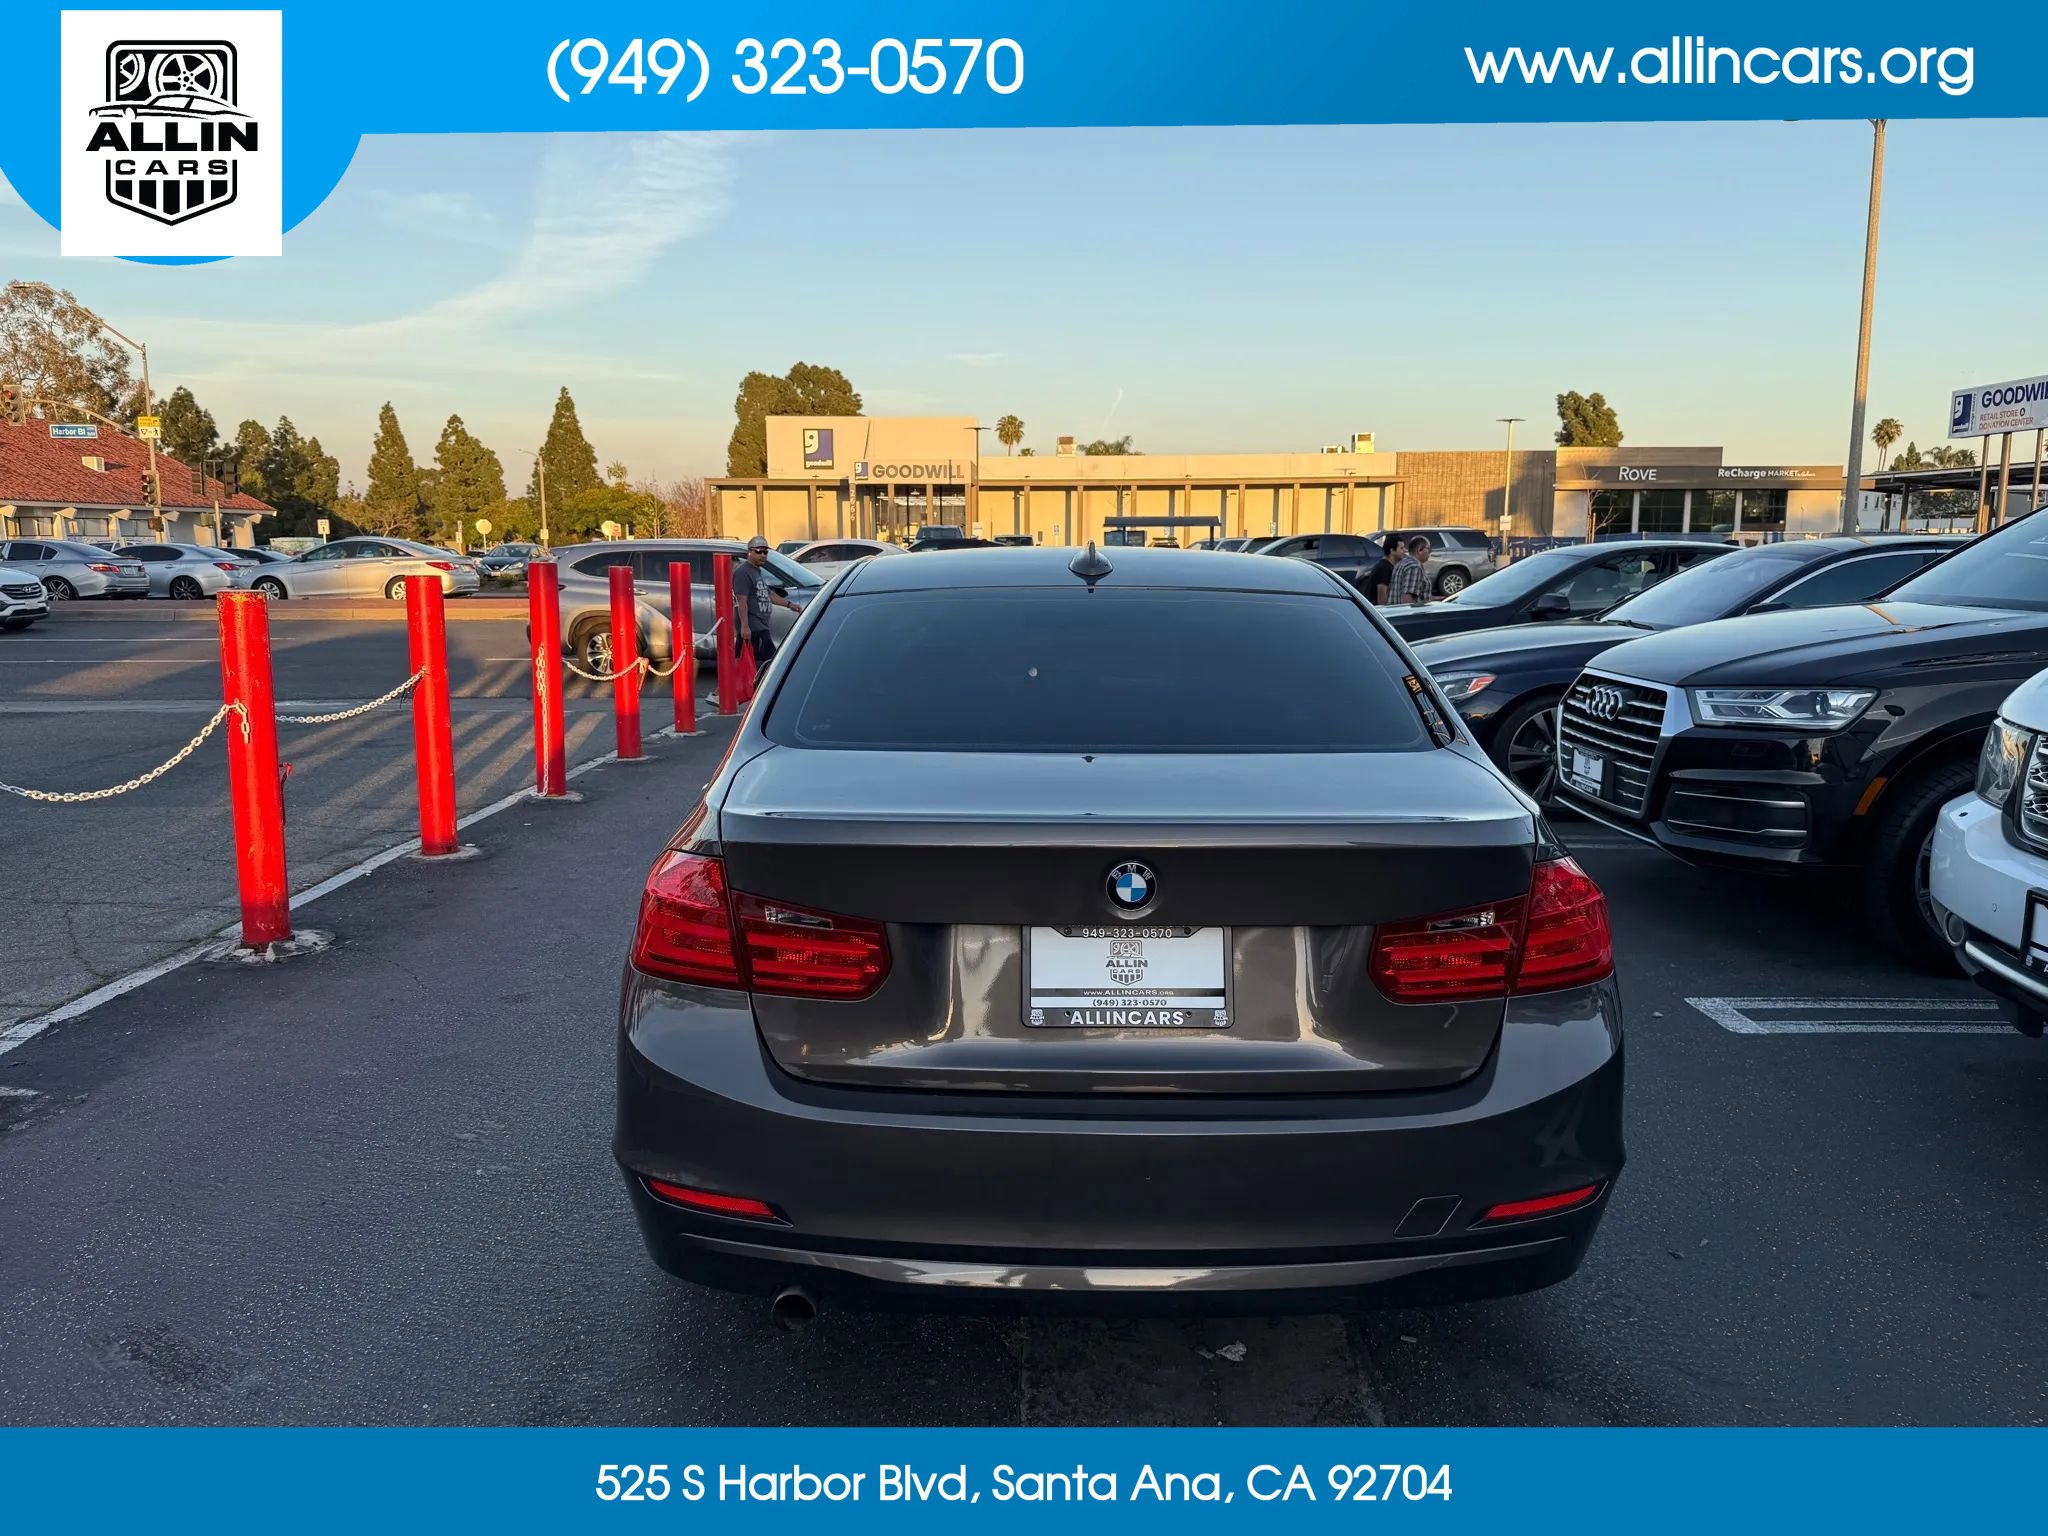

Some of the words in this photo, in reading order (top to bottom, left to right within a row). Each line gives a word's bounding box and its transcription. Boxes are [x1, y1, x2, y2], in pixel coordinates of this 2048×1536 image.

[2000, 409, 2018, 419] STORE
[2010, 416, 2033, 427] CENTER
[53, 428, 76, 436] Harbor
[872, 464, 964, 479] GOODWILL
[1718, 468, 1767, 480] ReCharge
[1111, 864, 1153, 881] BMW
[1082, 928, 1173, 939] 949-323-0570
[1105, 959, 1148, 968] ALLIN
[1092, 999, 1119, 1007] (949)
[1120, 999, 1167, 1007] 323-0570
[1070, 1010, 1184, 1025] ALLINCARS
